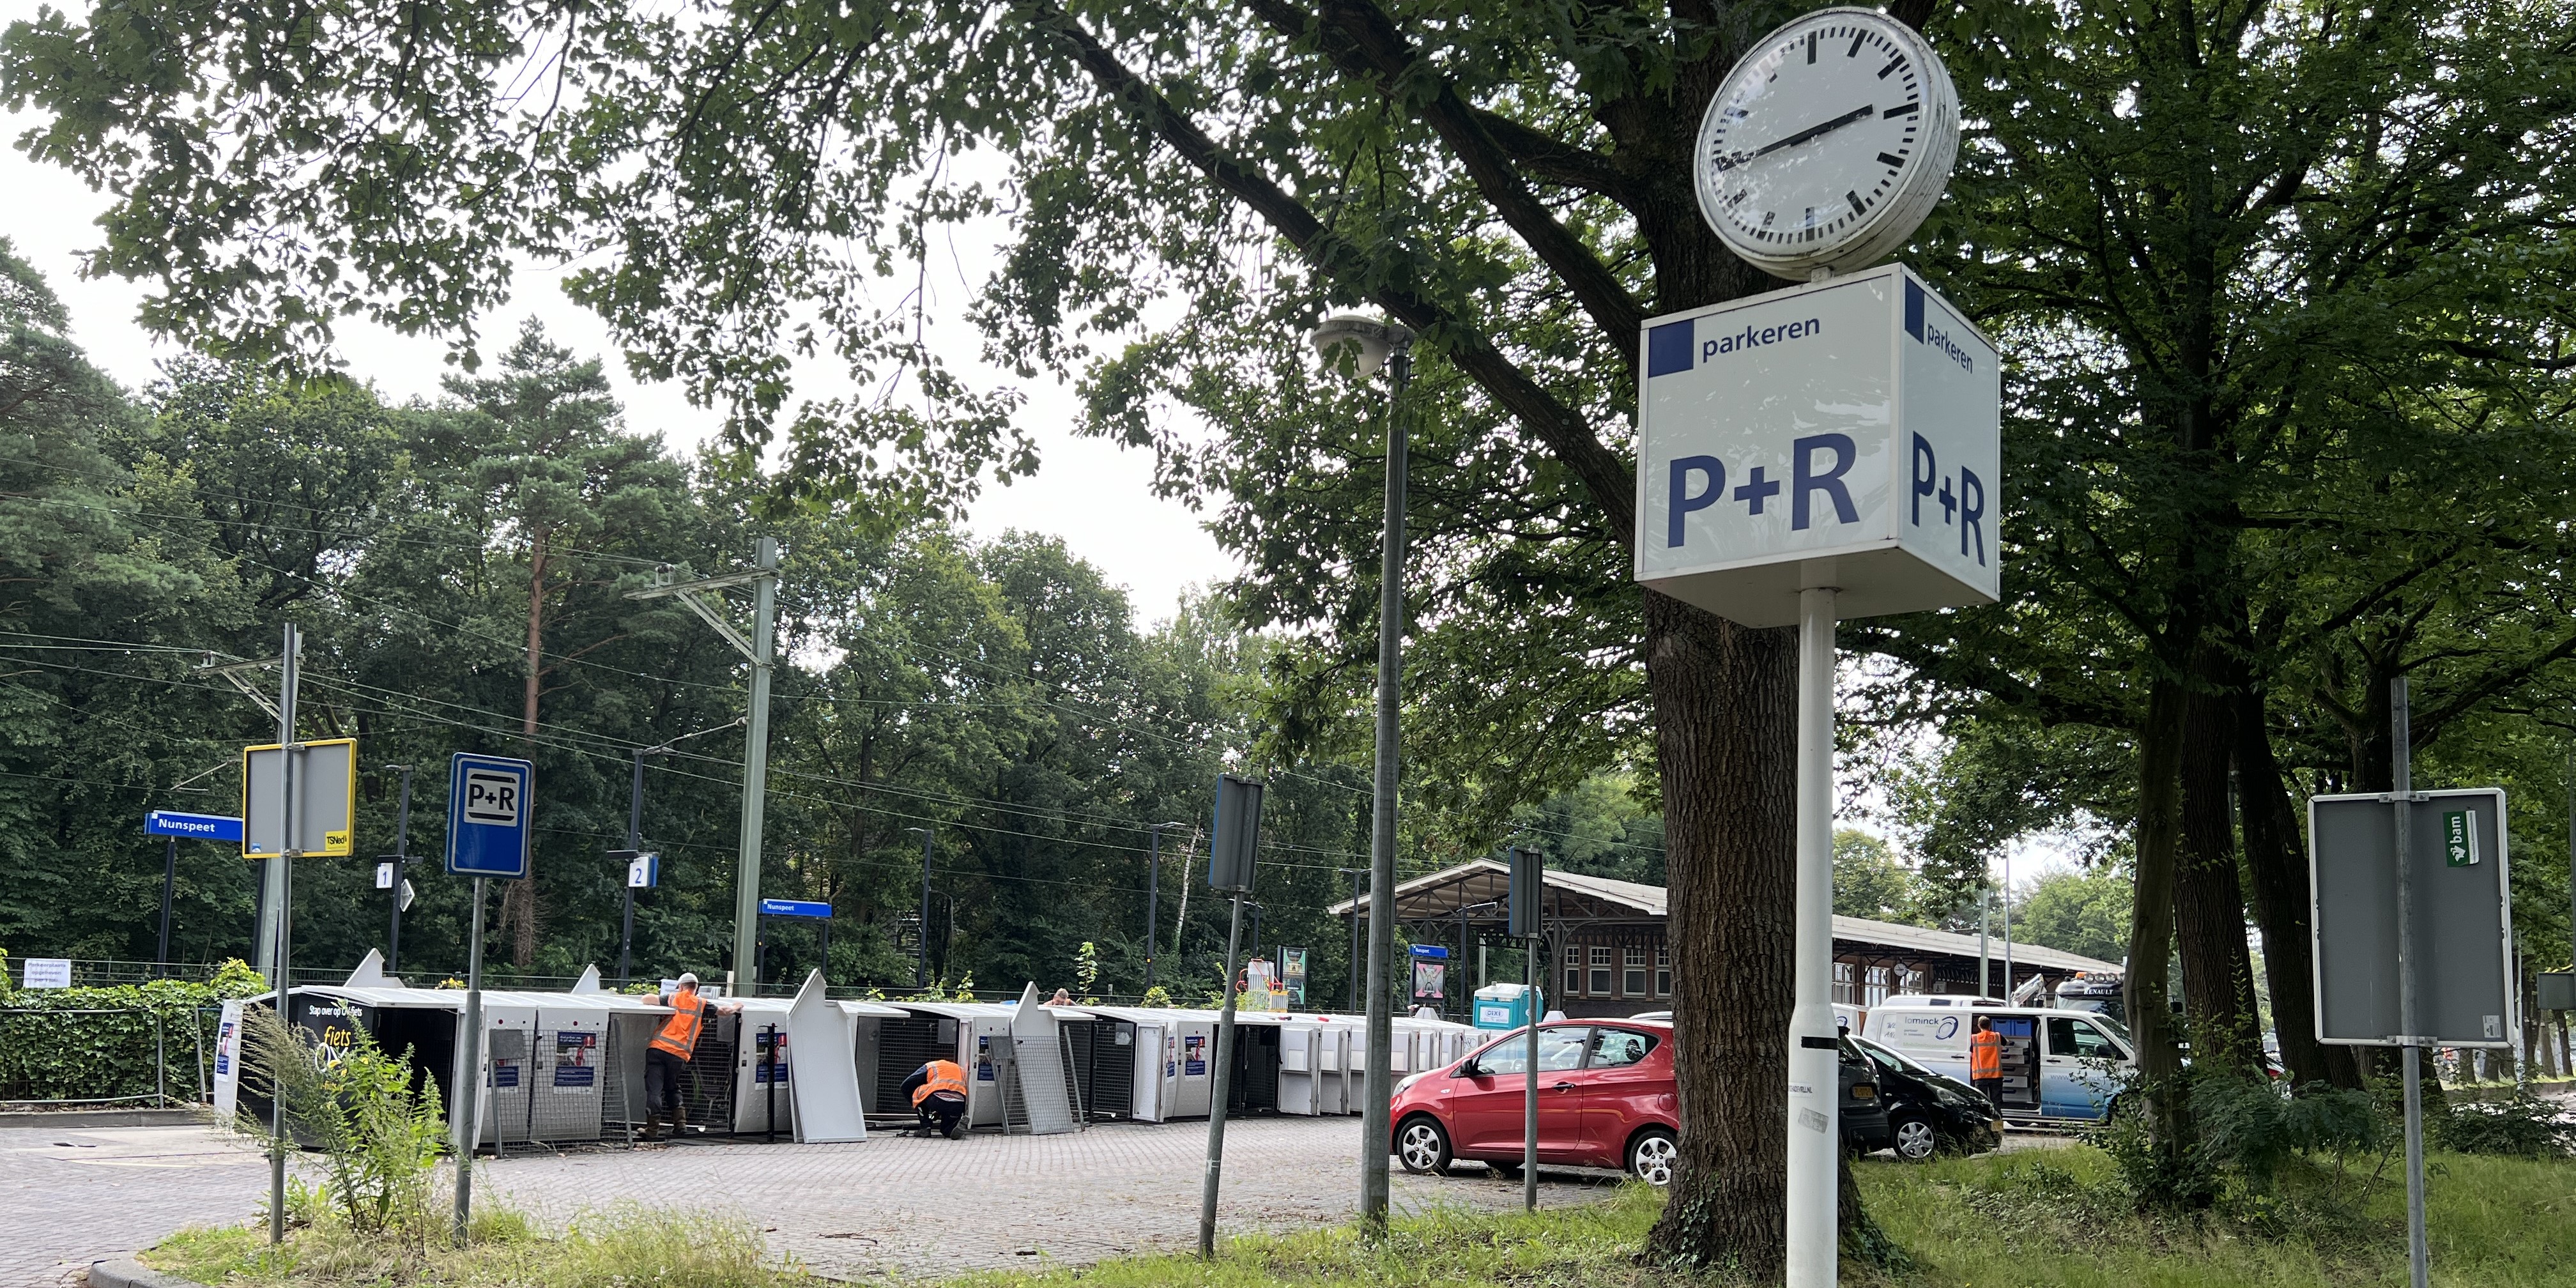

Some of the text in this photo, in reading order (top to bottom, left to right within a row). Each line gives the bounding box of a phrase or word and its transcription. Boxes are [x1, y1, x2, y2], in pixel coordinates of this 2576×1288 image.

[1703, 319, 1820, 364] parkeren
[1928, 323, 1972, 374] parkeren
[1667, 433, 1860, 548] P+R
[1912, 431, 1986, 567] P+R
[468, 784, 515, 811] P+R
[158, 818, 215, 832] Nunspeet
[2450, 816, 2462, 843] bam
[383, 871, 387, 885] 1
[635, 868, 641, 884] 2
[309, 1005, 321, 1016] Stap
[321, 1008, 333, 1016] over
[334, 1008, 341, 1018] op
[1905, 1016, 1939, 1025] lominck
[325, 1025, 351, 1046] fiets
